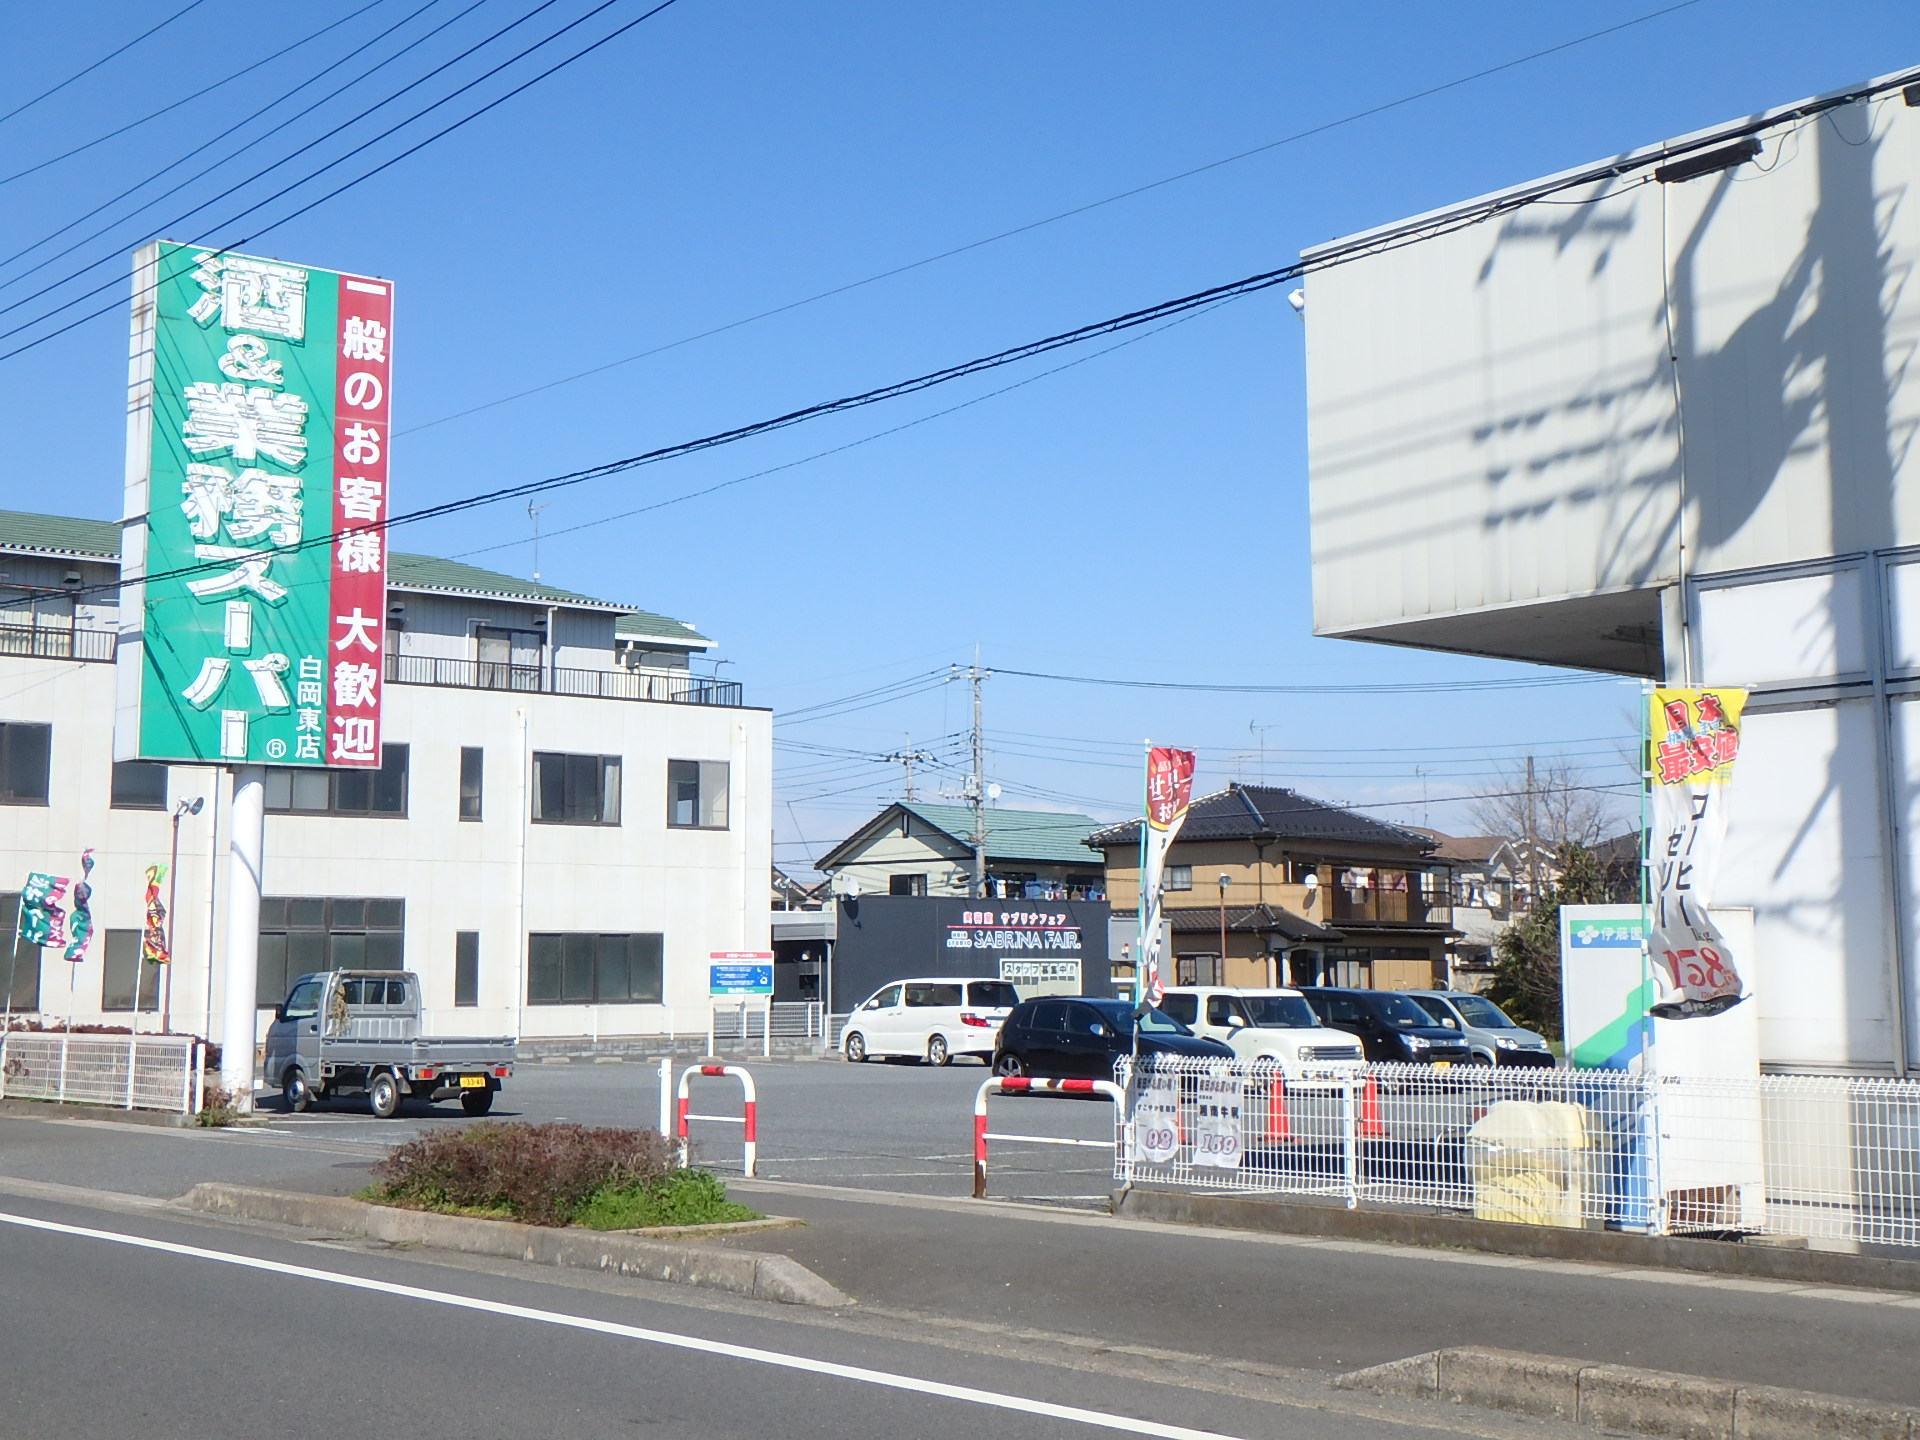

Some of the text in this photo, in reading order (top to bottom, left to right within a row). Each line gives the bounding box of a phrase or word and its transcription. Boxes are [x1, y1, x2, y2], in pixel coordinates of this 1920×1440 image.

[181, 250, 309, 758] 酒&業務スーパー
[331, 279, 386, 763] 一般のお客様 大歓迎
[295, 654, 322, 759] 白岡東店
[1664, 693, 1725, 735] 日本
[1656, 725, 1740, 785] 最安値
[1660, 824, 1687, 928] ゼリー
[1675, 793, 1709, 927] コーヒー
[1000, 911, 1067, 926] サブリナフェア
[1690, 927, 1714, 942] 1kg
[1663, 947, 1724, 990] 158
